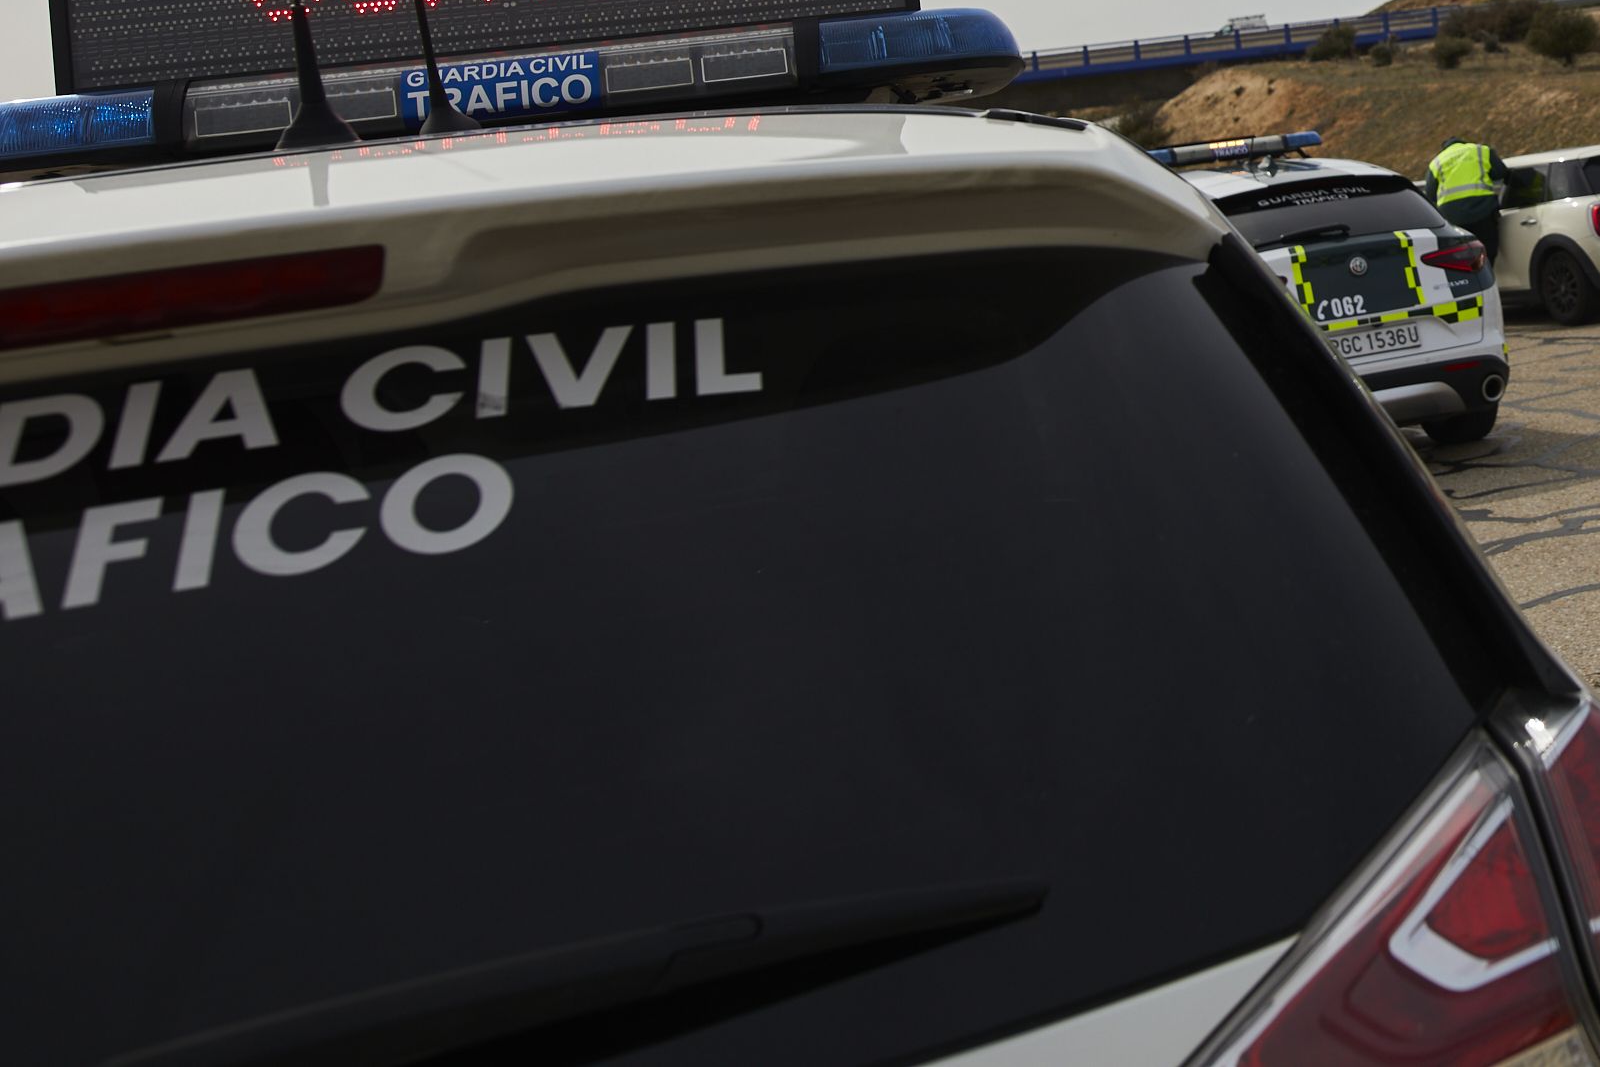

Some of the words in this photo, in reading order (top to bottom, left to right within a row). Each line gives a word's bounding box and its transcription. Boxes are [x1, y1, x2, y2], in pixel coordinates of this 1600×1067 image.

[406, 60, 525, 87] GARDIA
[529, 54, 593, 74] CIVIL
[407, 74, 592, 121] TRAFICO
[1258, 189, 1328, 207] GUARDIA
[1333, 186, 1371, 194] CIVIL
[1293, 194, 1349, 206] TRAFICO
[1331, 295, 1367, 318] 062
[340, 318, 763, 432] CIVIL
